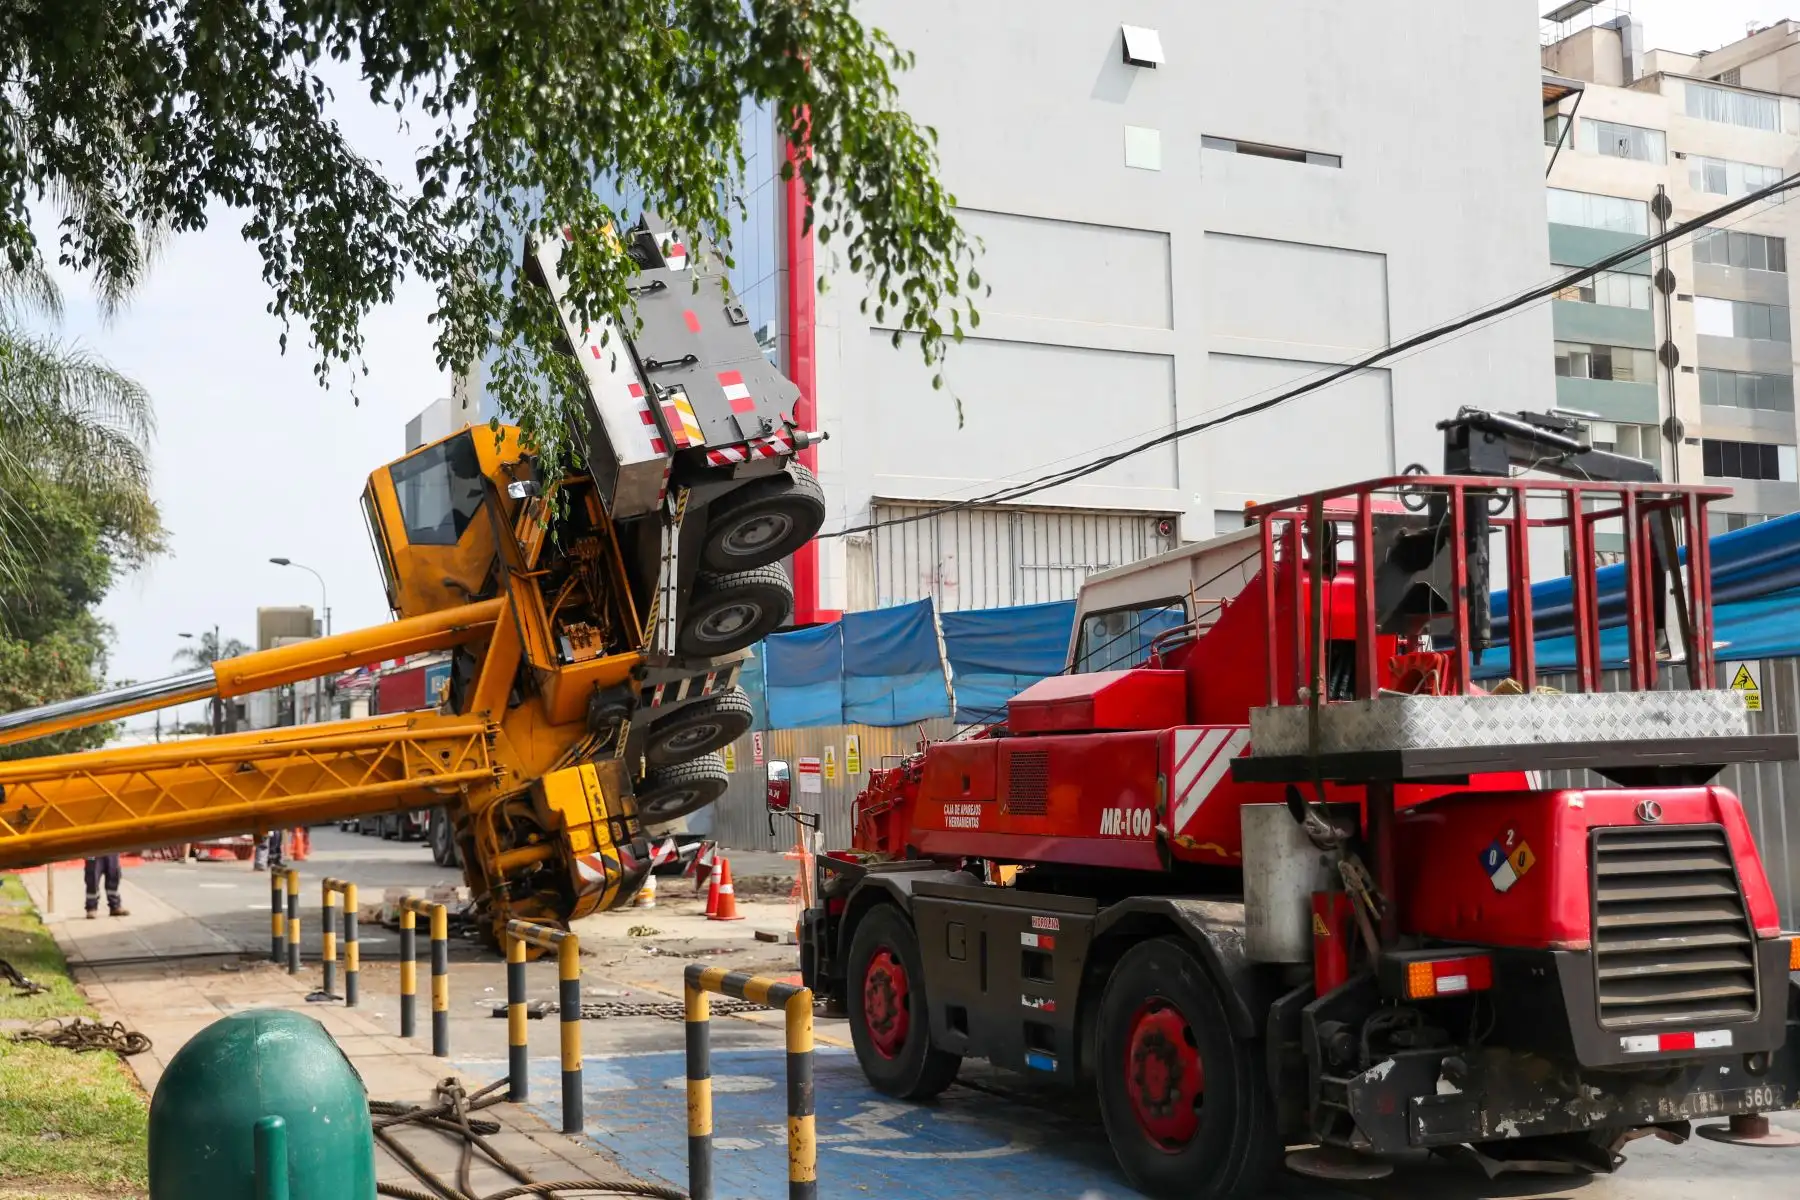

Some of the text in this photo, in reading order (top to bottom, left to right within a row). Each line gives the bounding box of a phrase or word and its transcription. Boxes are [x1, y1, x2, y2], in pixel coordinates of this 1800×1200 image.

[944, 803, 954, 815] CAJA
[954, 803, 961, 815] DE
[945, 816, 949, 828] Y
[1100, 807, 1151, 837] MR-100
[1506, 829, 1514, 845] 2
[1489, 849, 1497, 866] 0
